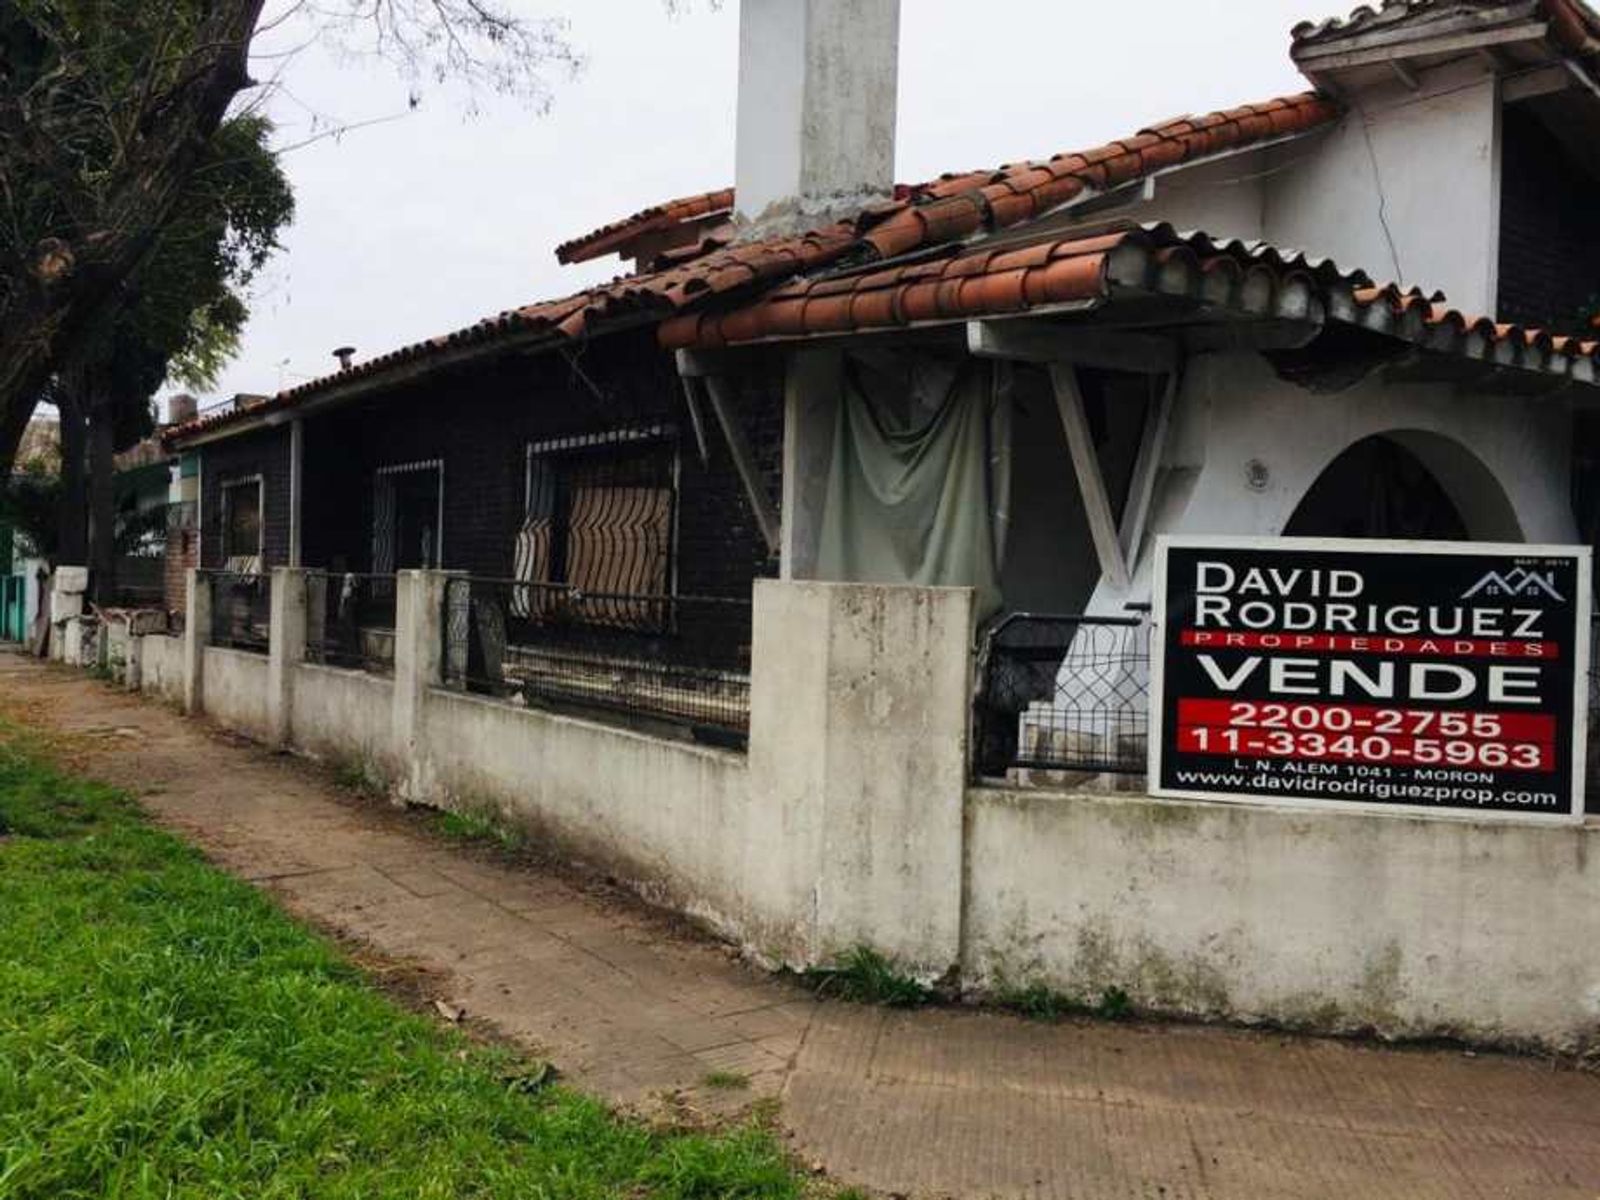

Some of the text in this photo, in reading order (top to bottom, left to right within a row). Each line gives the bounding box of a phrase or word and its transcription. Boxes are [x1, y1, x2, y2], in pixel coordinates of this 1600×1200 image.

[1195, 561, 1364, 598] DAVID
[1195, 595, 1544, 639] RODRIGUEZ
[1194, 633, 1544, 657] PROPIEDADES
[1196, 655, 1542, 704] VENDE
[1229, 703, 1502, 739] 2200-2755
[1191, 728, 1541, 769] 11-3340-5963
[1177, 771, 1557, 805] www.davidrodriguezprop.com
[1234, 759, 1248, 770] L.
[1255, 761, 1275, 772] N.
[1282, 762, 1338, 775] ALEM
[1347, 765, 1392, 778] 1041
[1415, 769, 1494, 783] MORON
